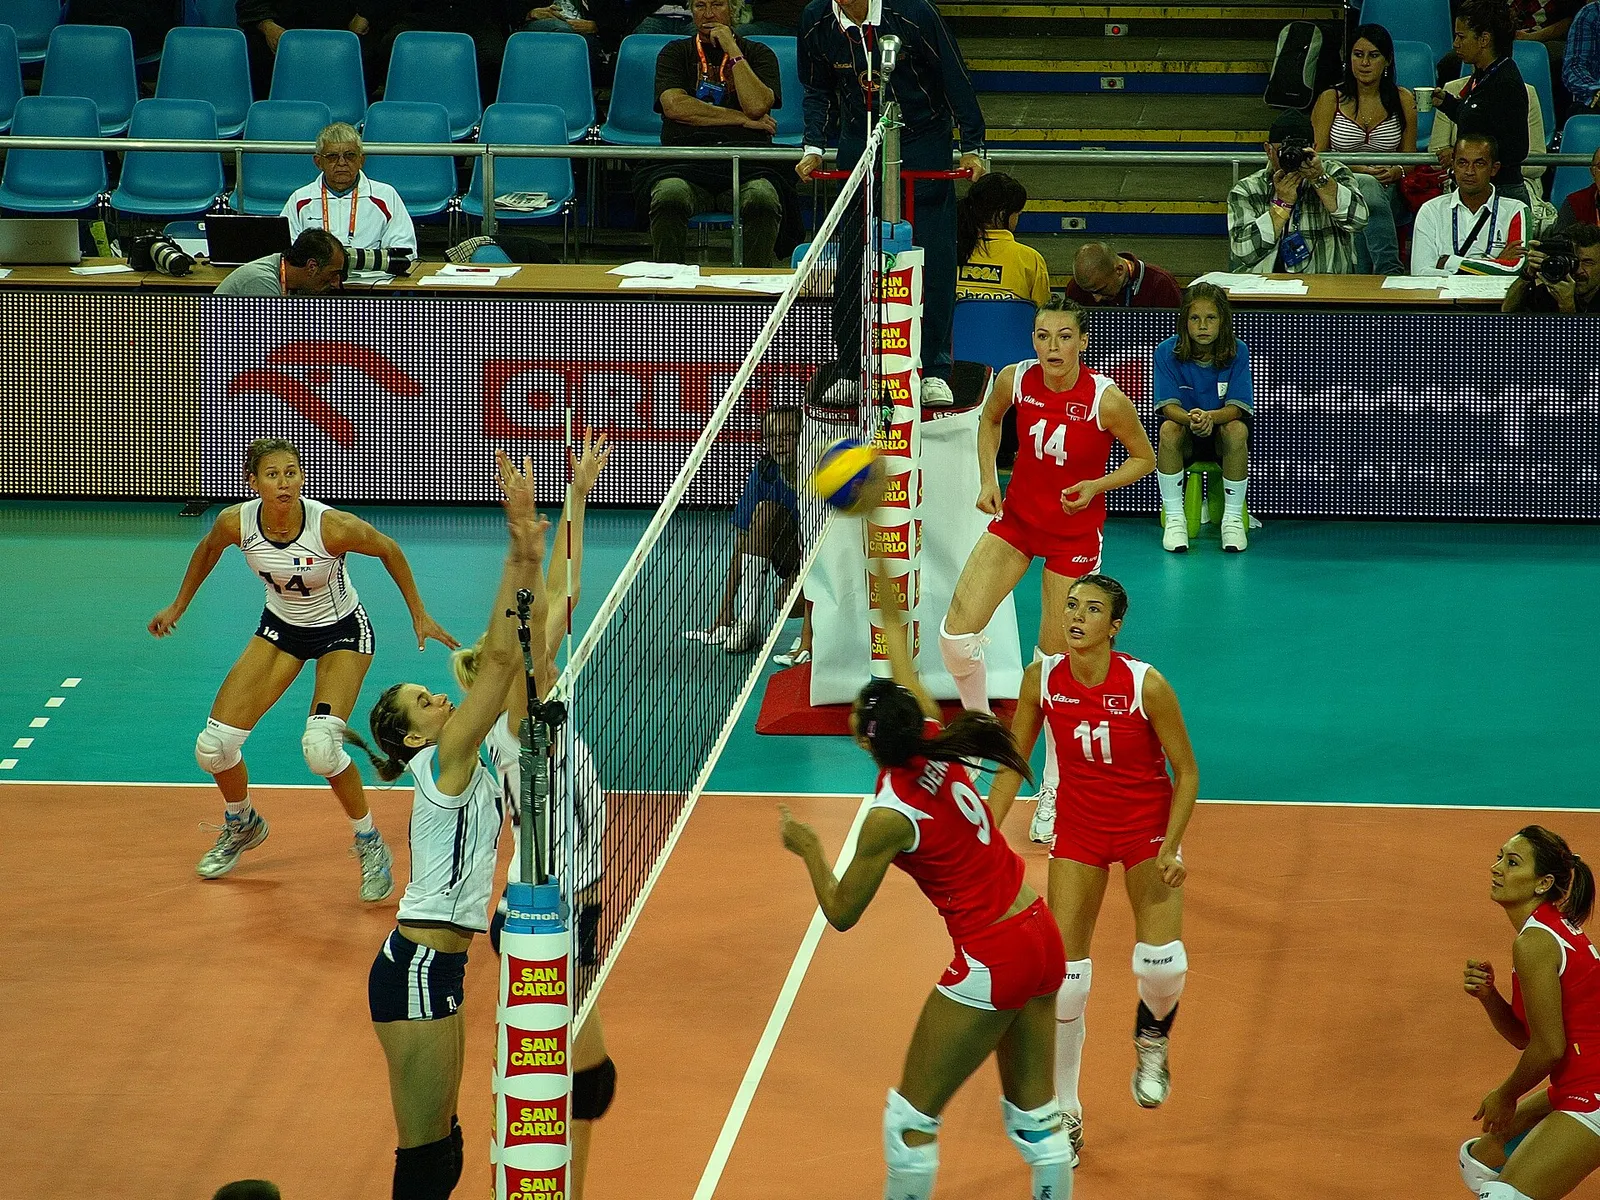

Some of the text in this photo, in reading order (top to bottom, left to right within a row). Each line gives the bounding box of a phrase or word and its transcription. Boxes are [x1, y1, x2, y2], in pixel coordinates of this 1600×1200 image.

[1029, 419, 1067, 466] 14
[875, 532, 900, 542] SAN
[869, 541, 907, 552] CARLO
[259, 571, 312, 596] 14
[1073, 720, 1112, 764] 11
[951, 781, 991, 845] 9
[510, 909, 559, 920] Senoh
[521, 968, 558, 982] SAN
[511, 981, 566, 996] CARLO
[520, 1038, 558, 1052] SAN
[510, 1051, 566, 1066] CARLO
[520, 1108, 557, 1122] SAN
[509, 1121, 565, 1136] CARLO
[520, 1178, 557, 1192] SAN
